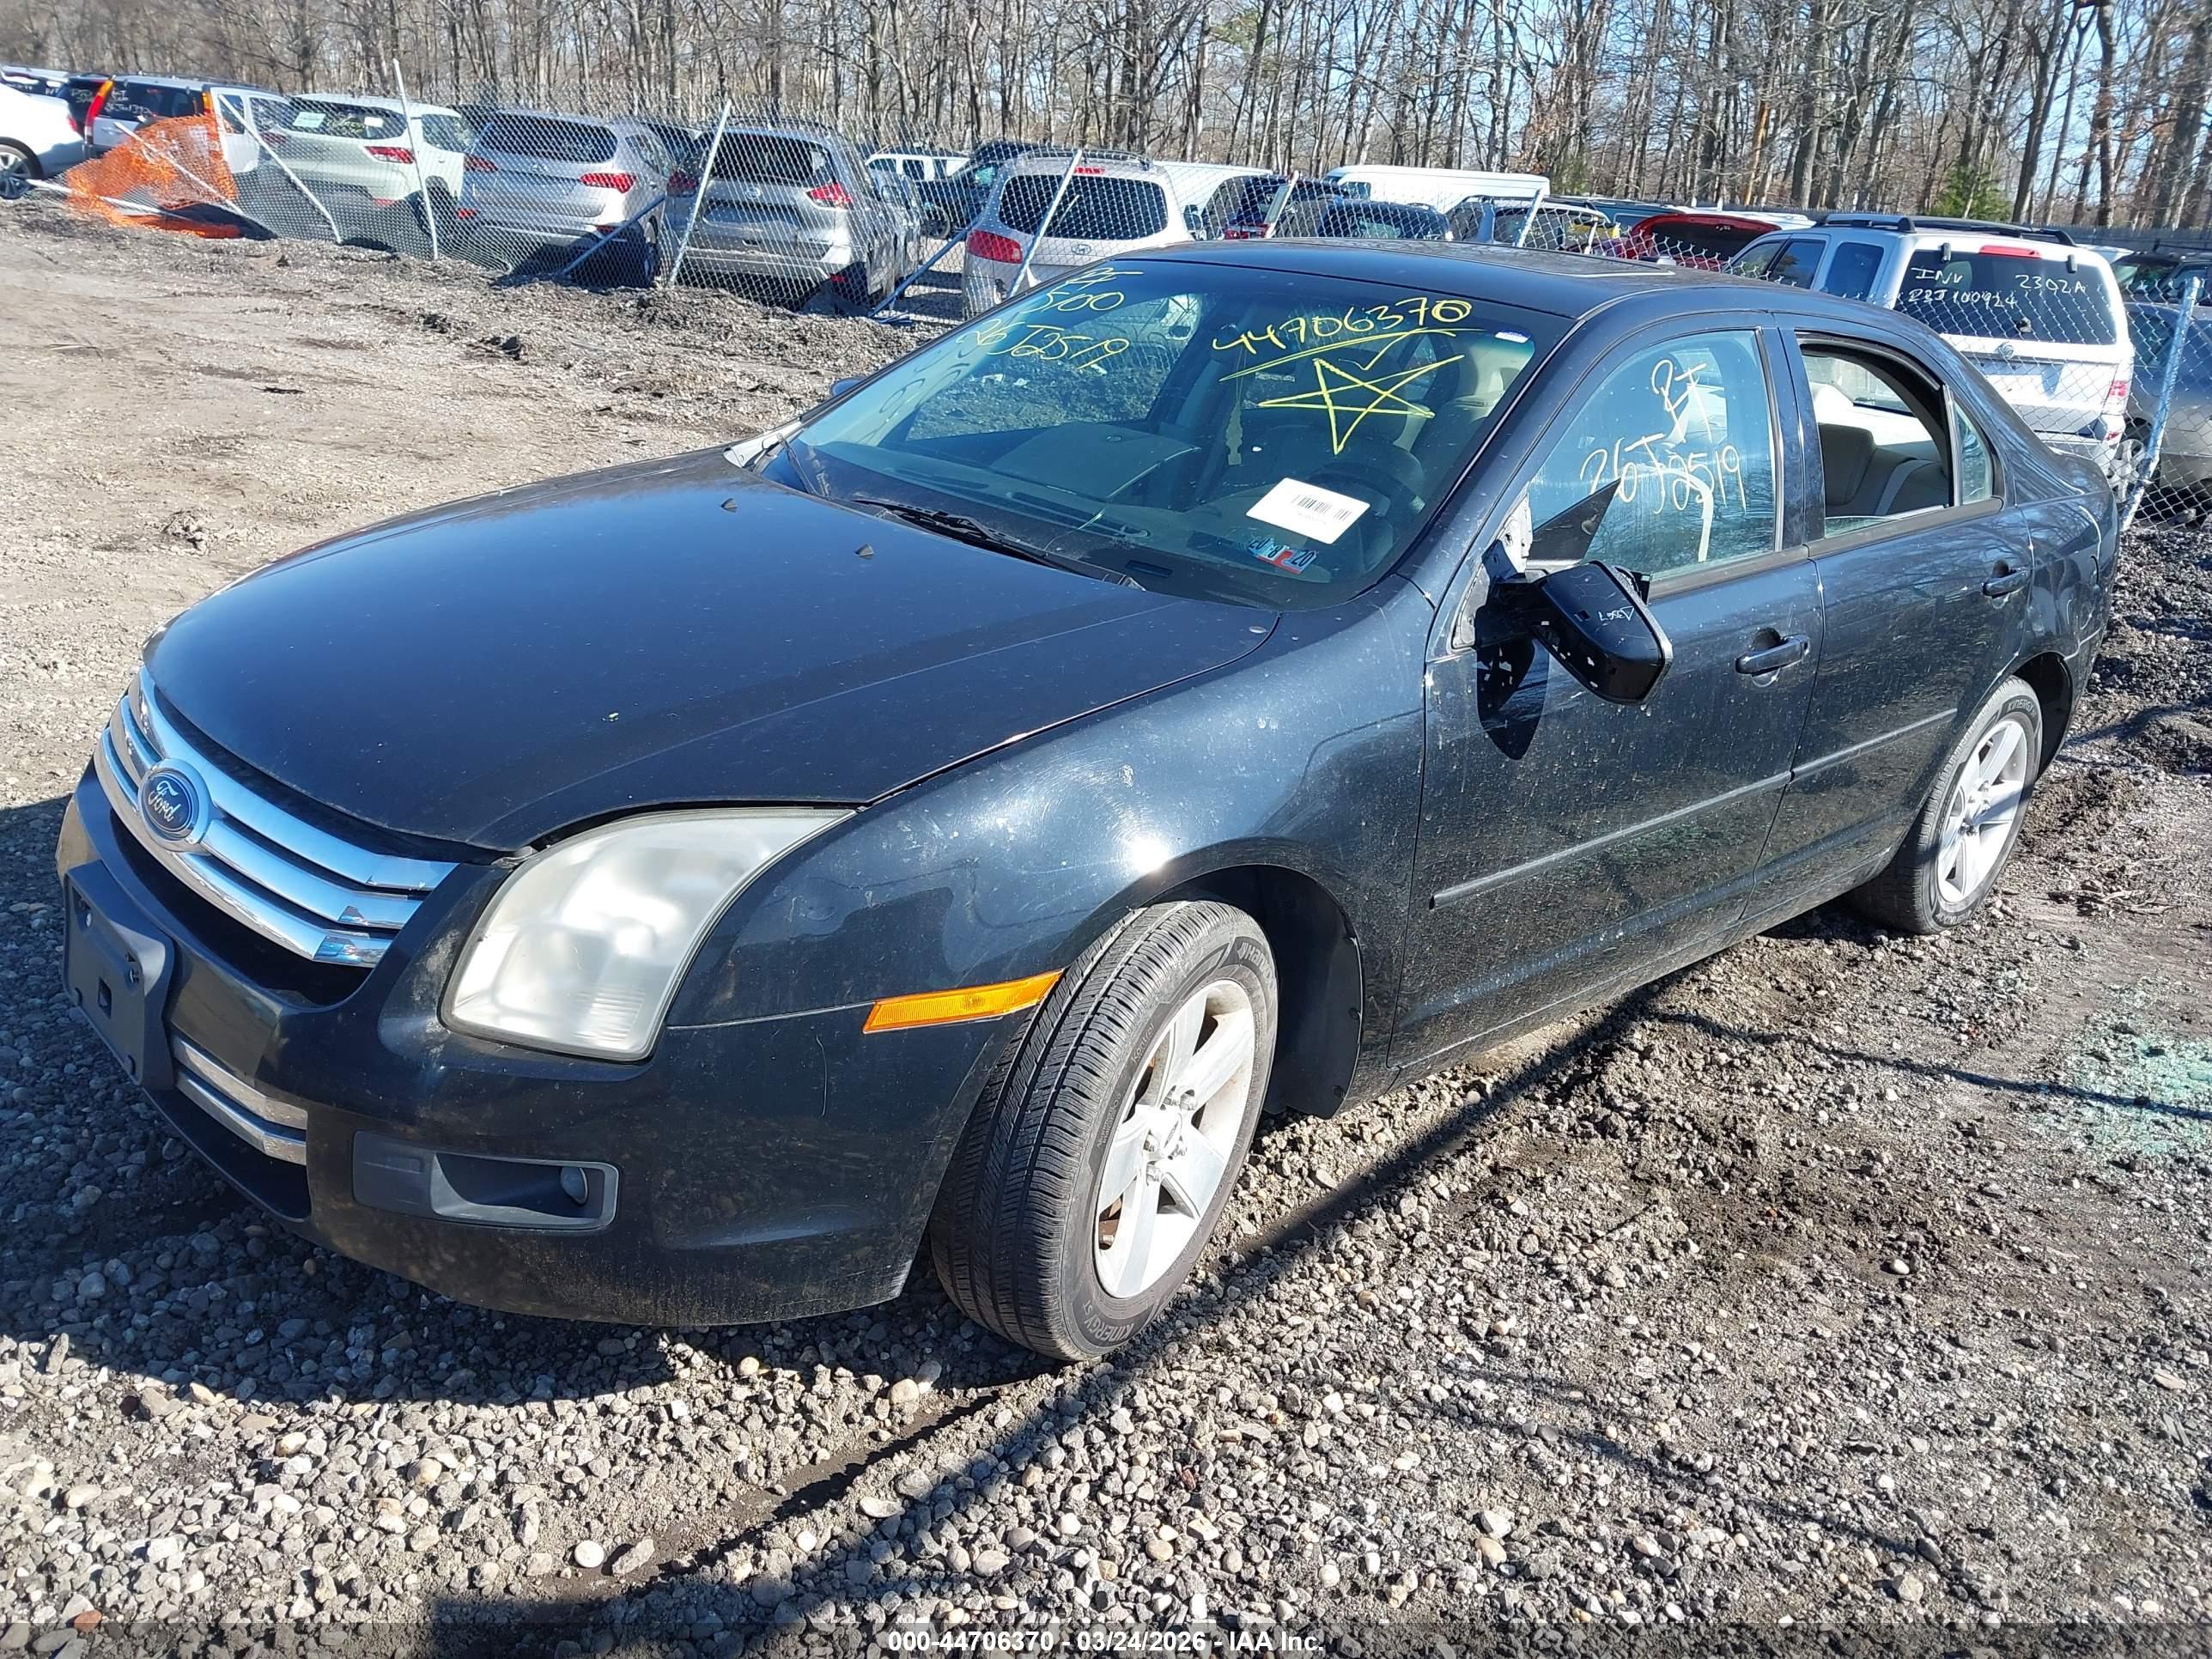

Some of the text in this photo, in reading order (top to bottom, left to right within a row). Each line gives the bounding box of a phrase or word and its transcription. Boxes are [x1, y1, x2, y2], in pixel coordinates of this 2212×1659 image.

[1910, 267, 1963, 284] INV
[1212, 296, 1474, 354] 44706370
[148, 781, 182, 823] Ford
